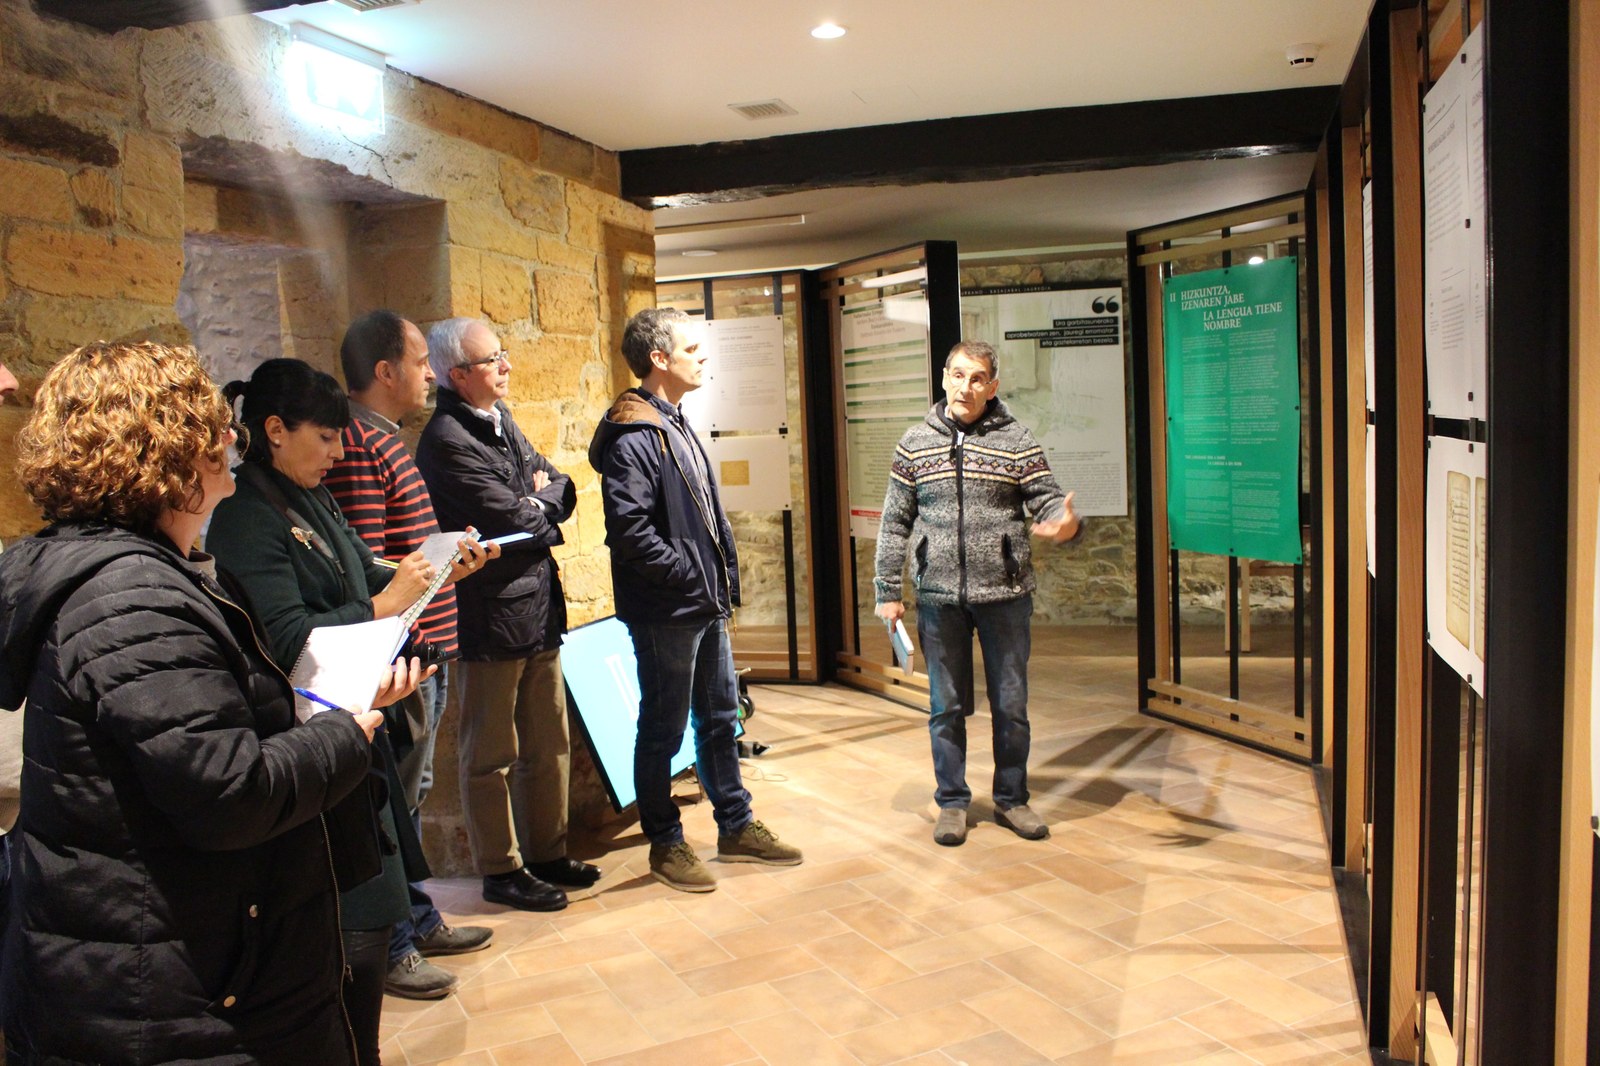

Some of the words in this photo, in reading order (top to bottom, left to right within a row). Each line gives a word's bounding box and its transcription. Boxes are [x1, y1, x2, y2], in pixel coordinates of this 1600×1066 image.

[1181, 285, 1230, 301] HIZKUNTZA,
[1181, 297, 1222, 311] IZENAREN
[1223, 293, 1244, 308] JABE
[1203, 311, 1214, 321] LA
[1216, 306, 1253, 320] LENGUA
[1255, 302, 1282, 315] TIENE
[1203, 318, 1241, 331] NOMBRE
